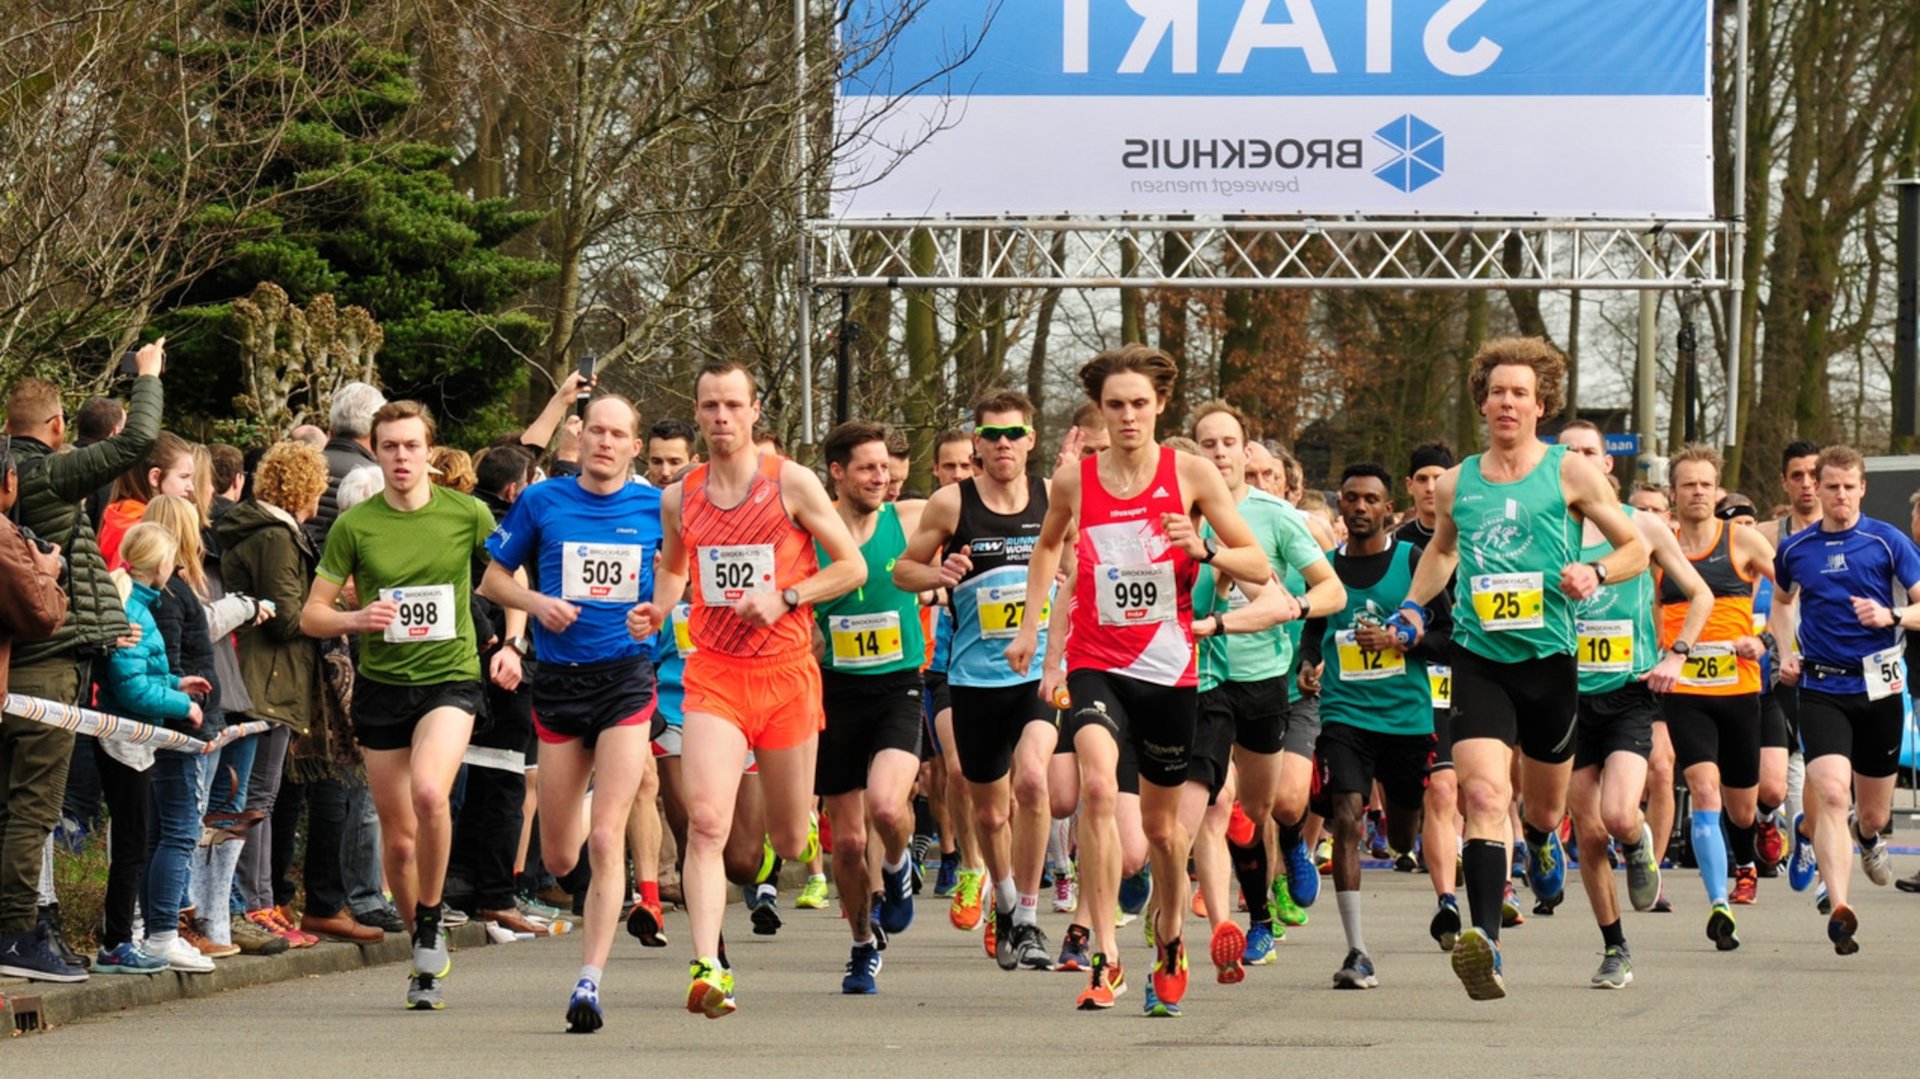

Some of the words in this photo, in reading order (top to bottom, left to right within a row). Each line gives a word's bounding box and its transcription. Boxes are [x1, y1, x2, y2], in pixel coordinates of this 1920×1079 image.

[582, 559, 622, 585] 503
[715, 562, 754, 588] 502
[1115, 582, 1157, 608] 999
[1492, 591, 1521, 620] 25
[399, 602, 438, 626] 998
[854, 630, 879, 657] 14
[1587, 638, 1611, 662] 10
[1359, 648, 1383, 670] 12
[1696, 656, 1719, 678] 26
